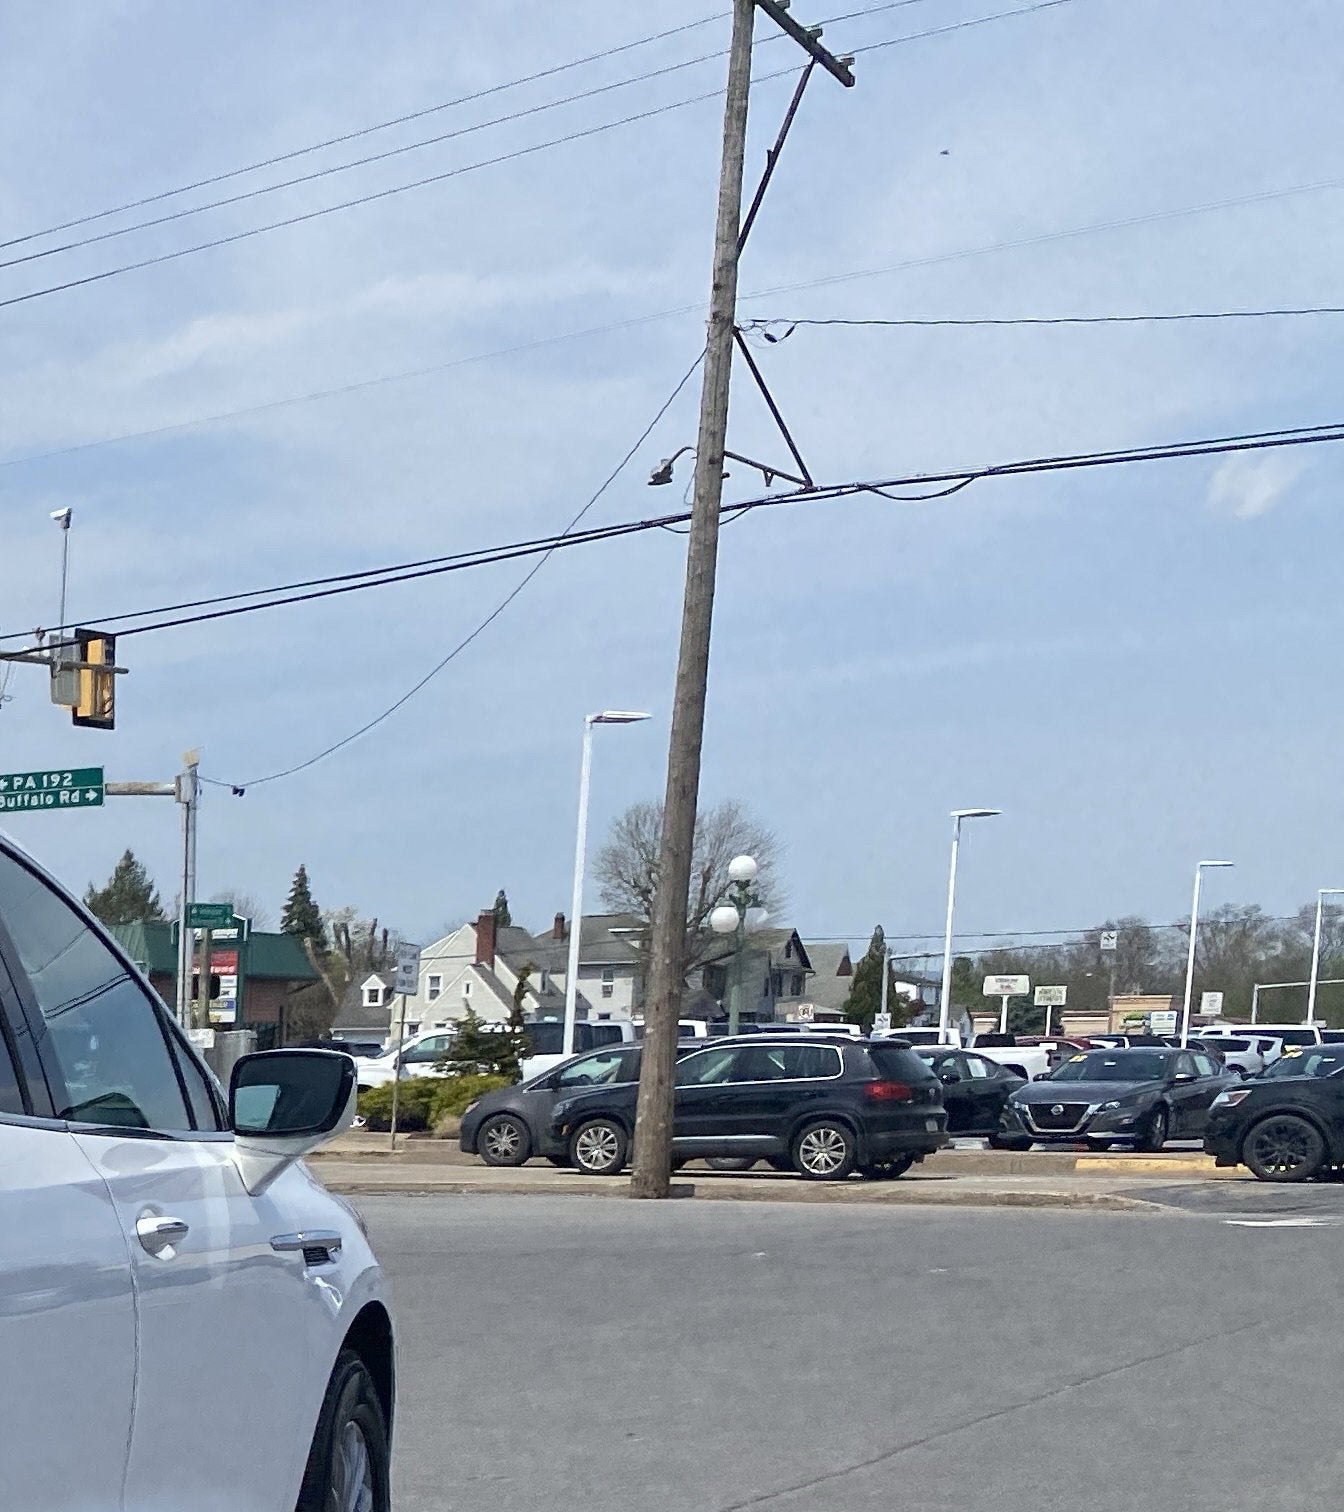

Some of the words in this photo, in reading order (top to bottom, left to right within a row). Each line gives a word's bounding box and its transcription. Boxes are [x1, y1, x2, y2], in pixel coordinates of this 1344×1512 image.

[13, 776, 36, 790] PA
[42, 772, 73, 788] 192
[59, 789, 80, 804] Rd
